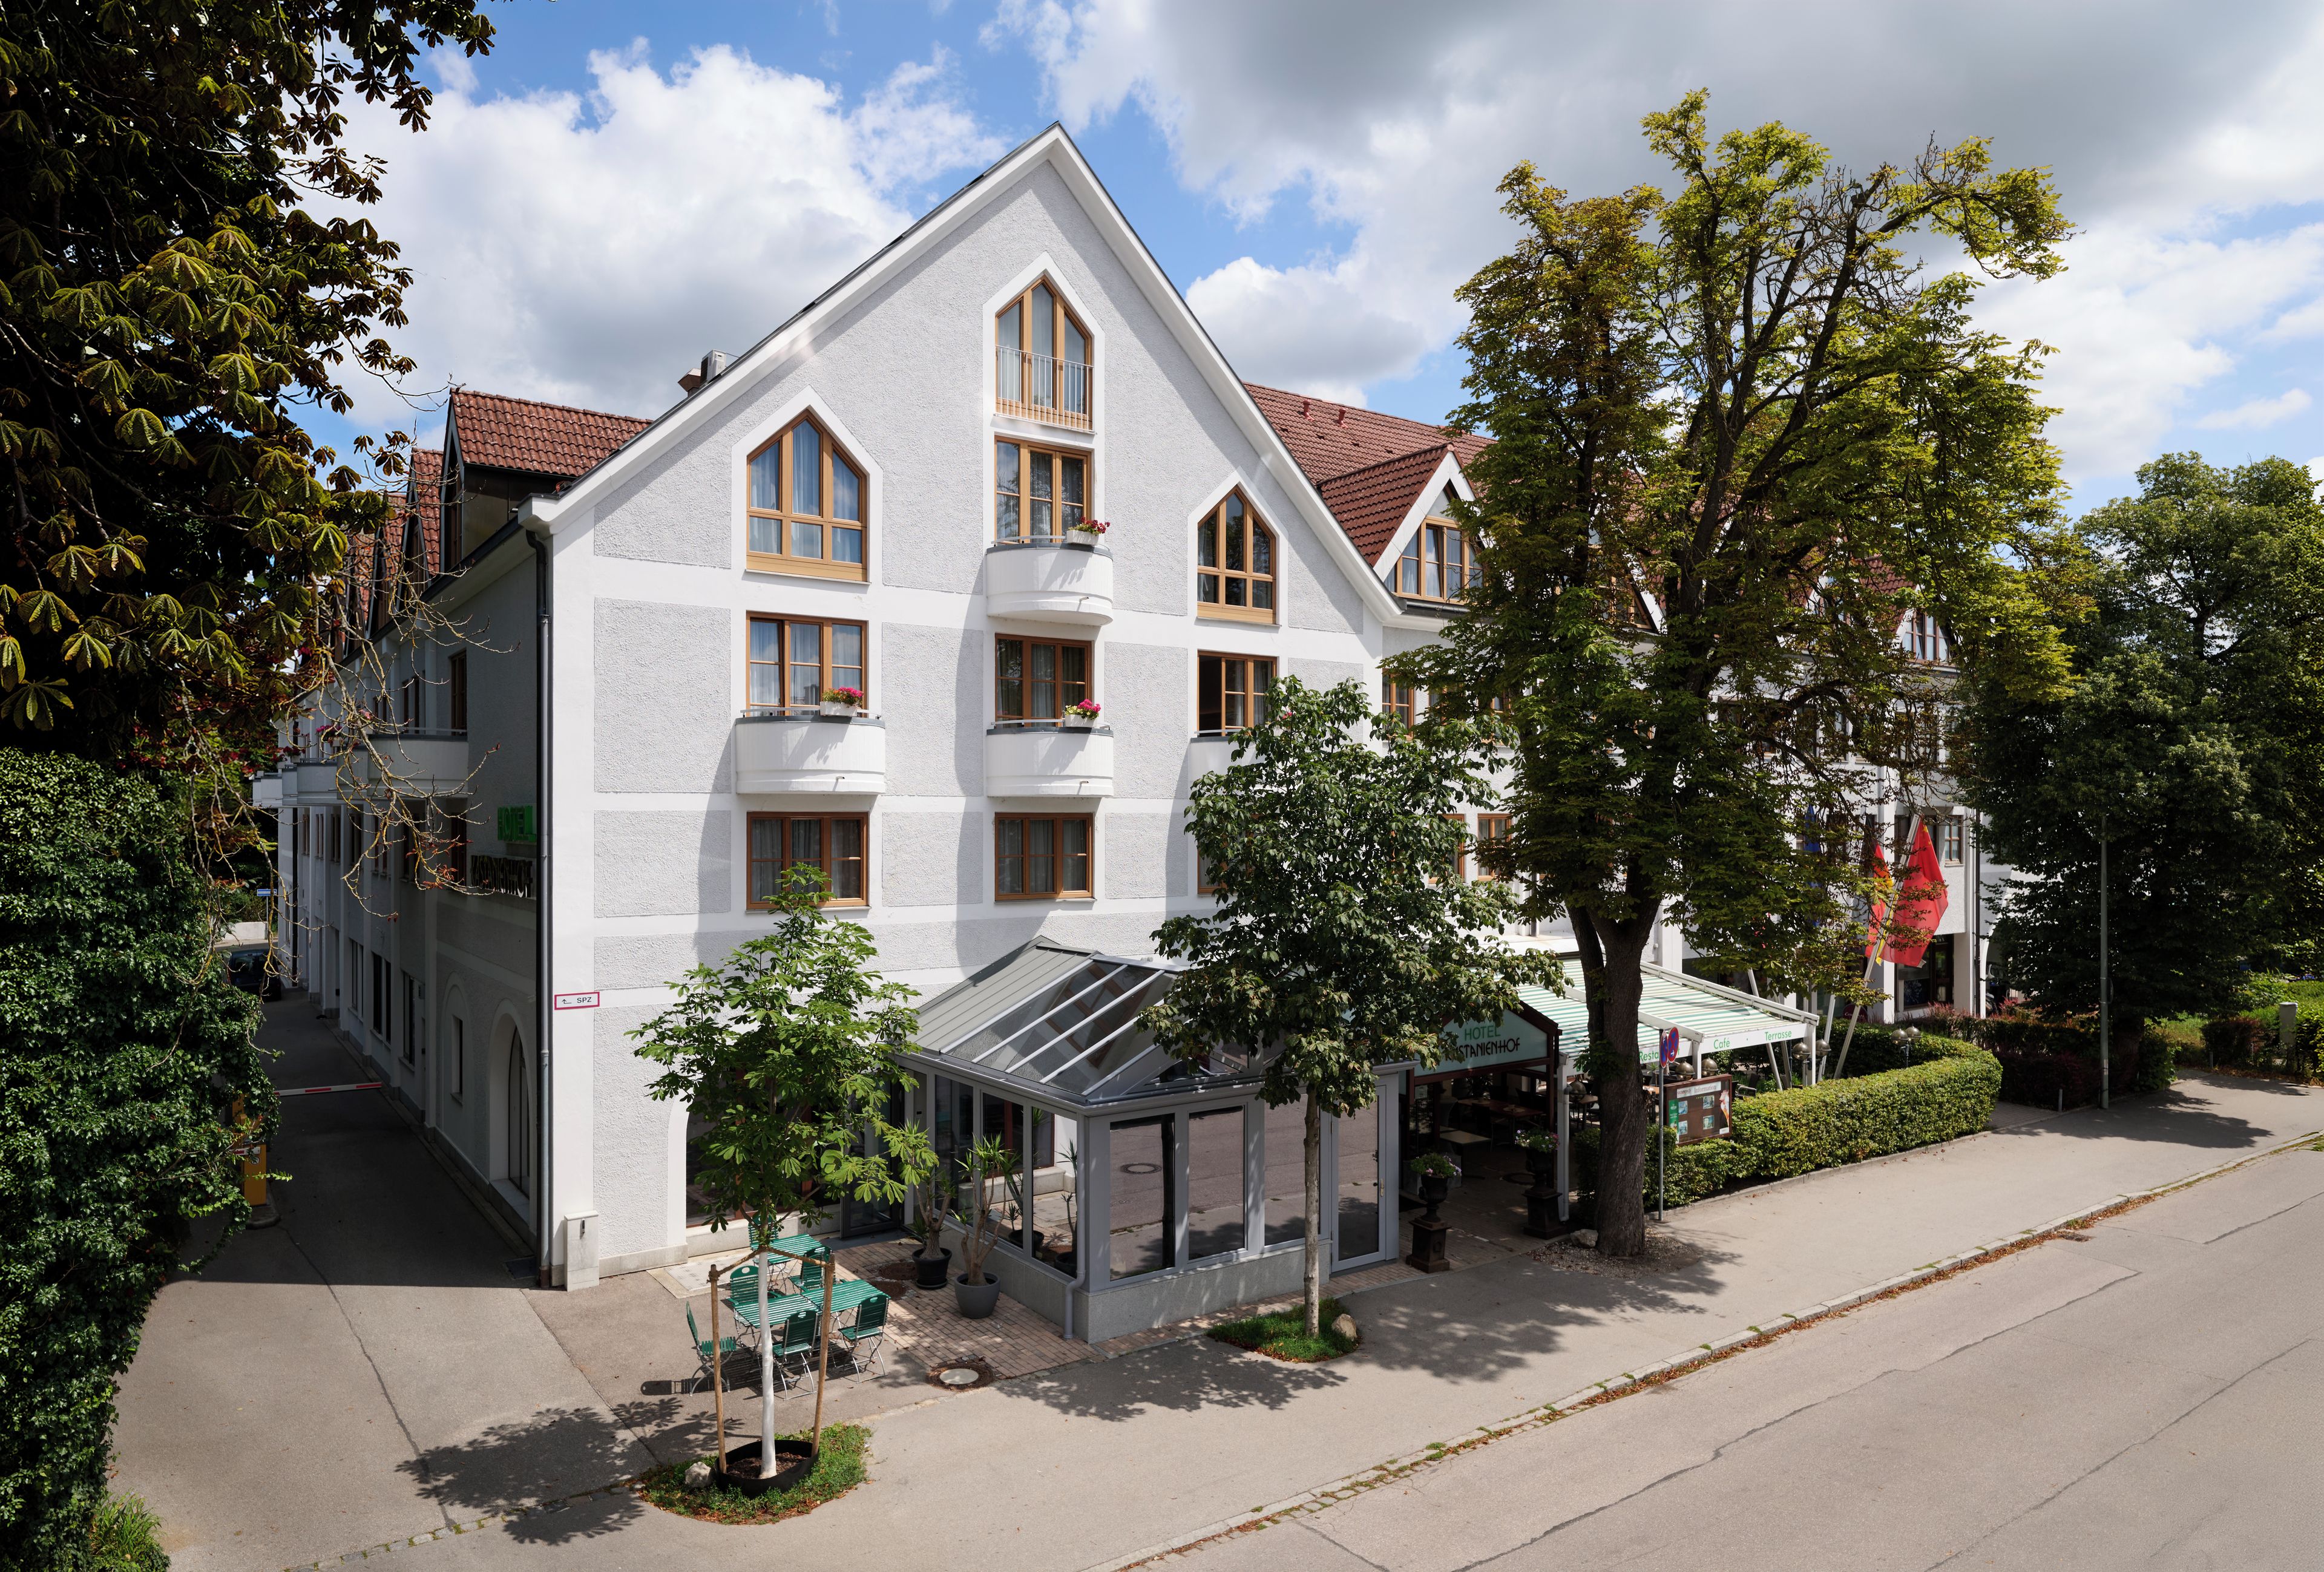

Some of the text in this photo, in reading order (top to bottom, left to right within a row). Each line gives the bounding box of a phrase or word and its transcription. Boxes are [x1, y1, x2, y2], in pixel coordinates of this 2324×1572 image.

[497, 806, 537, 842] HOTEL
[1464, 1024, 1500, 1041] HOTEL
[1713, 1030, 1792, 1049] Café Terrasse
[1450, 1037, 1520, 1058] STANIENHOF
[1639, 1047, 1680, 1061] Restat
[1694, 1085, 1716, 1093] Information
